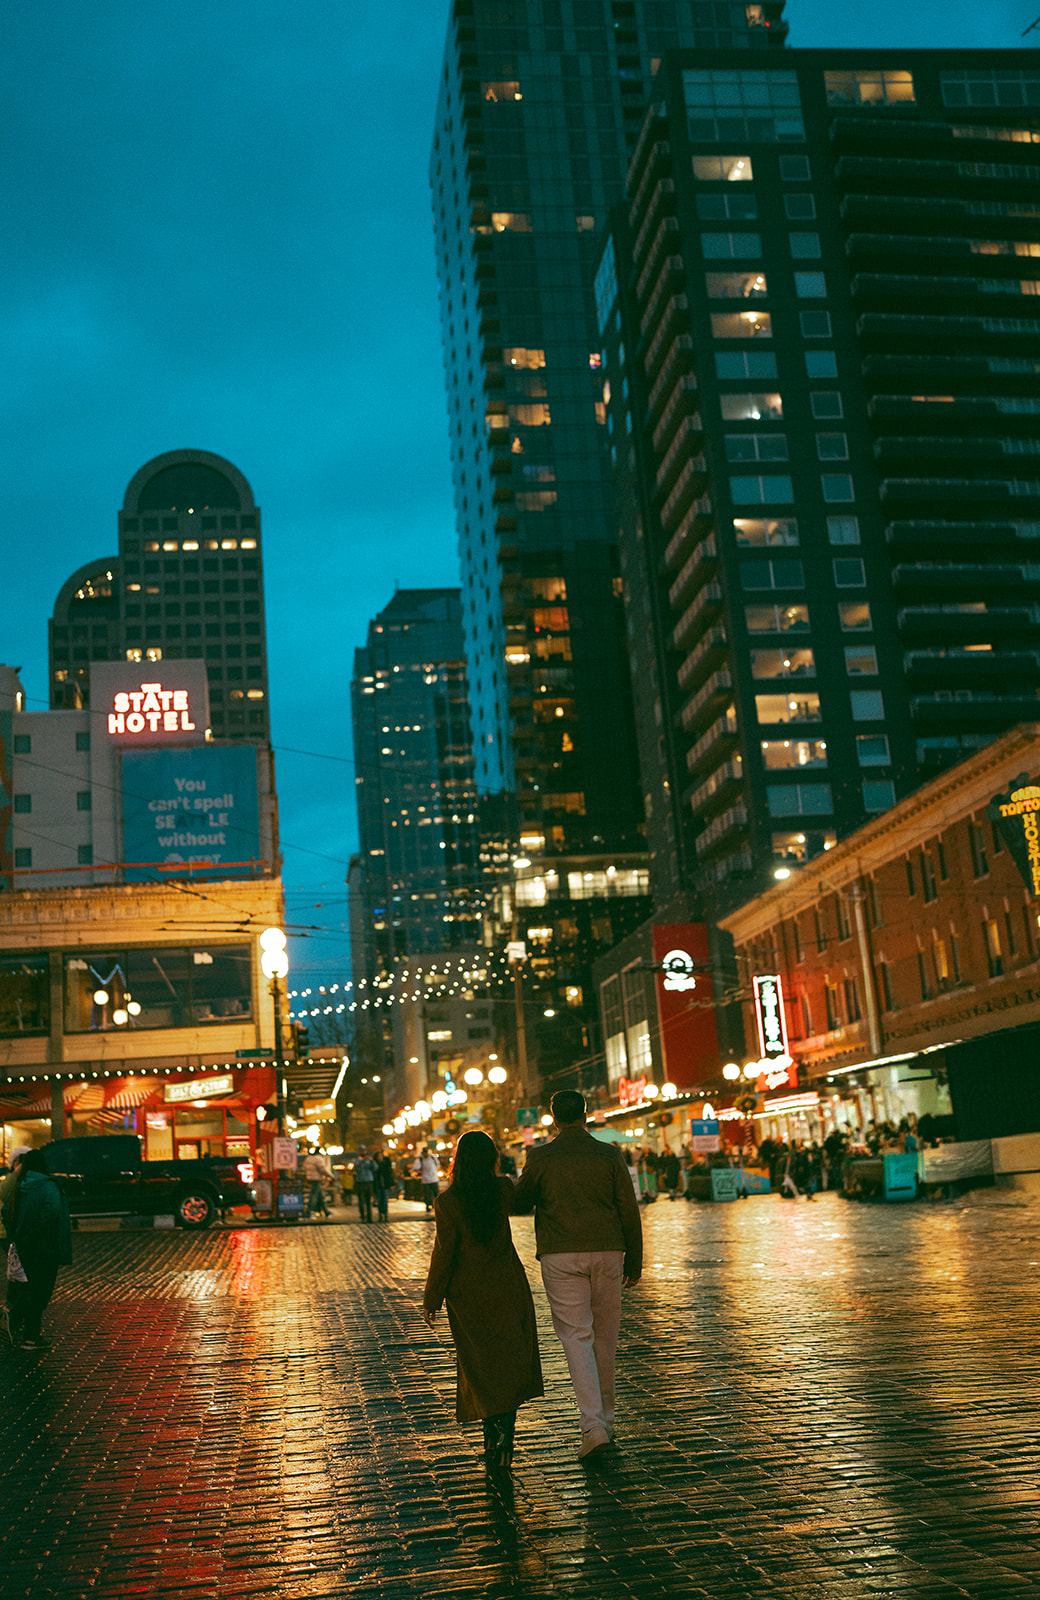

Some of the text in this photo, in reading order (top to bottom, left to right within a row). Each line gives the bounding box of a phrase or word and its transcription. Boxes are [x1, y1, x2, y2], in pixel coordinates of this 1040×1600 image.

[114, 690, 189, 712] STATE
[108, 711, 195, 733] HOTEL
[174, 778, 206, 792] You
[148, 794, 234, 813] can't spell
[158, 831, 226, 847] without
[1022, 812, 1040, 895] HOSTEL
